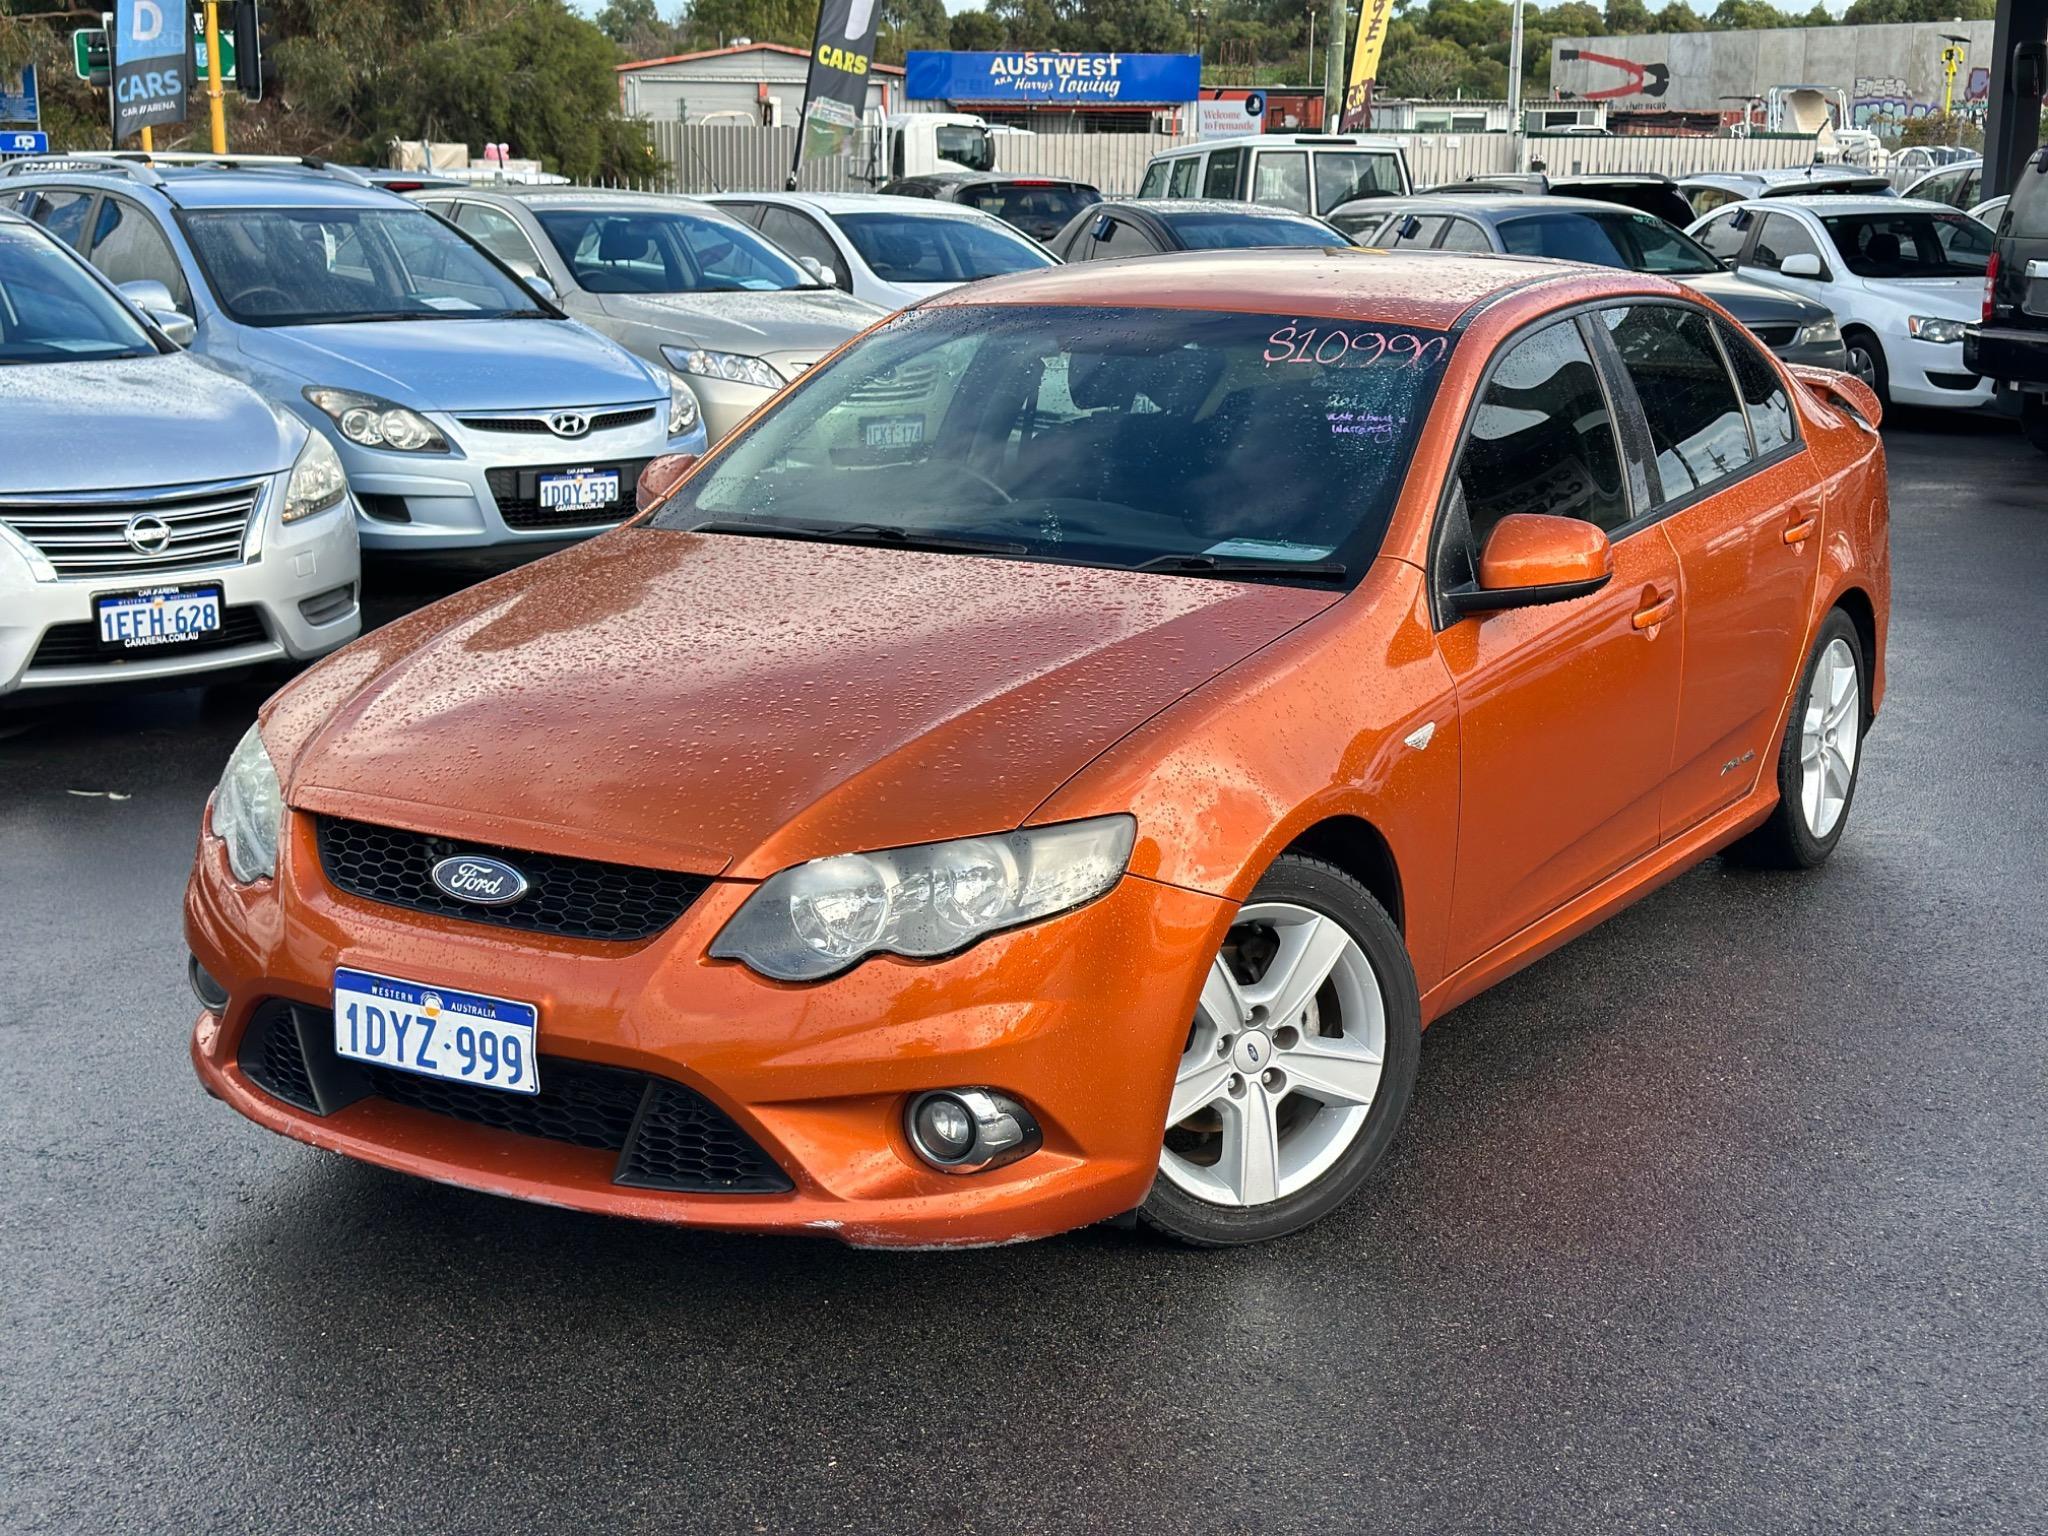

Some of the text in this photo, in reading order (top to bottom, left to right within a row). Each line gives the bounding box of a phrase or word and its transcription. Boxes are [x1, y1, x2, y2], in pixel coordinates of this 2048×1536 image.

[818, 44, 868, 75] CARS
[990, 56, 1122, 76] AUSTWEST
[118, 69, 182, 103] CARS
[1059, 75, 1121, 98] Towing
[121, 107, 139, 118] CAR
[146, 101, 176, 113] ARENA
[1203, 109, 1240, 120] Welcome
[1205, 120, 1255, 131] to Fremantle
[124, 632, 199, 648] CARARENA.COM.AU
[450, 863, 505, 895] Ford
[371, 985, 497, 1020] WESTERN AUSTRALIA
